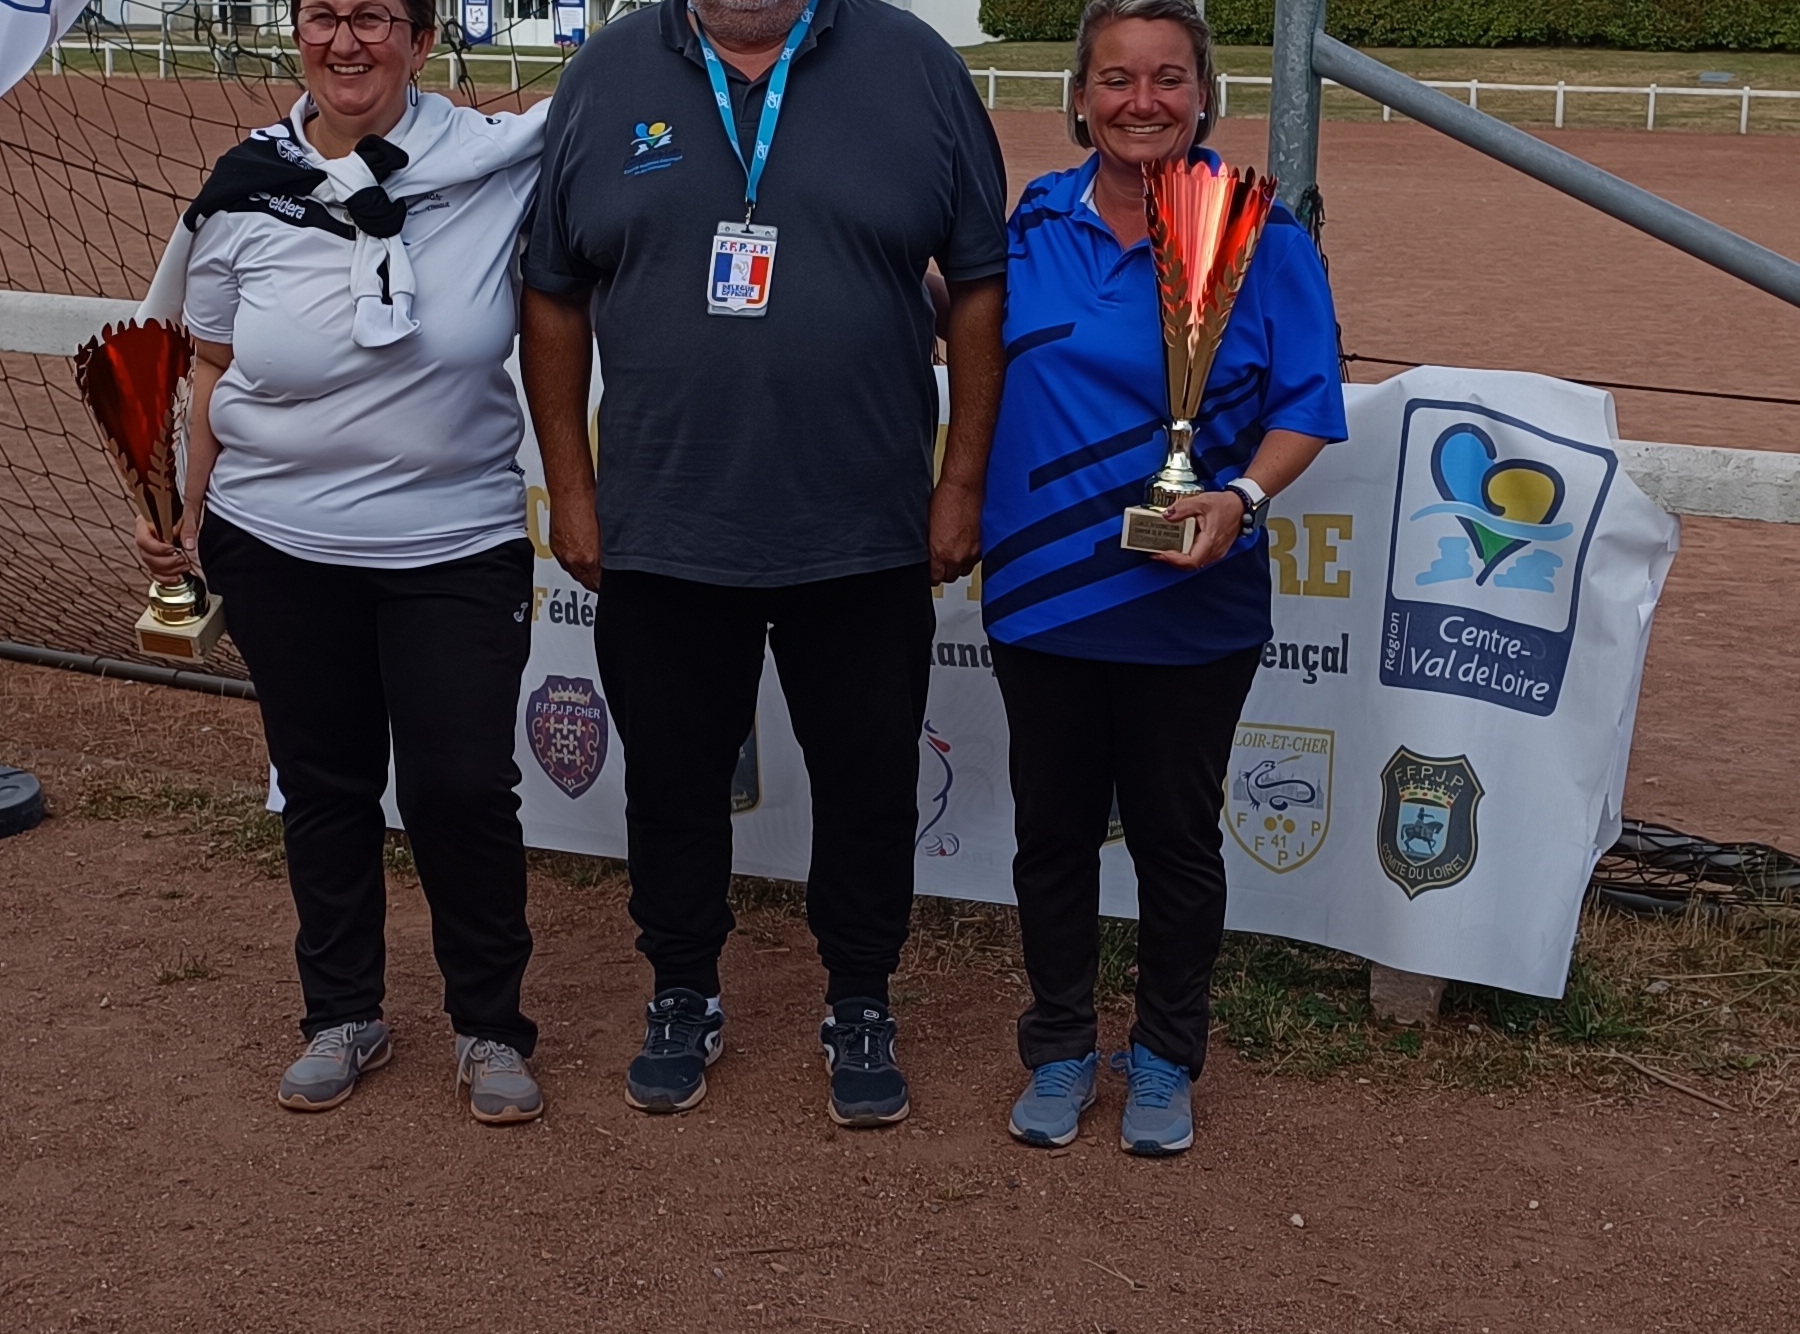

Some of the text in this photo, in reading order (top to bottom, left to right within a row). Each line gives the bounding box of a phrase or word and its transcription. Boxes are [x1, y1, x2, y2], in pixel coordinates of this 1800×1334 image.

[268, 194, 306, 220] eldera
[1267, 513, 1354, 599] RE
[1260, 632, 1350, 685] ençal
[1384, 612, 1400, 671] Région
[1439, 615, 1531, 660] Centre-
[1410, 646, 1550, 702] Val de Loire
[574, 705, 601, 720] CHER
[1234, 731, 1329, 755] LOIR-ET-CHER
[1236, 812, 1321, 866] F F P J P
[1270, 833, 1287, 849] 41
[1382, 842, 1466, 880] COMITE DU LOIRET
